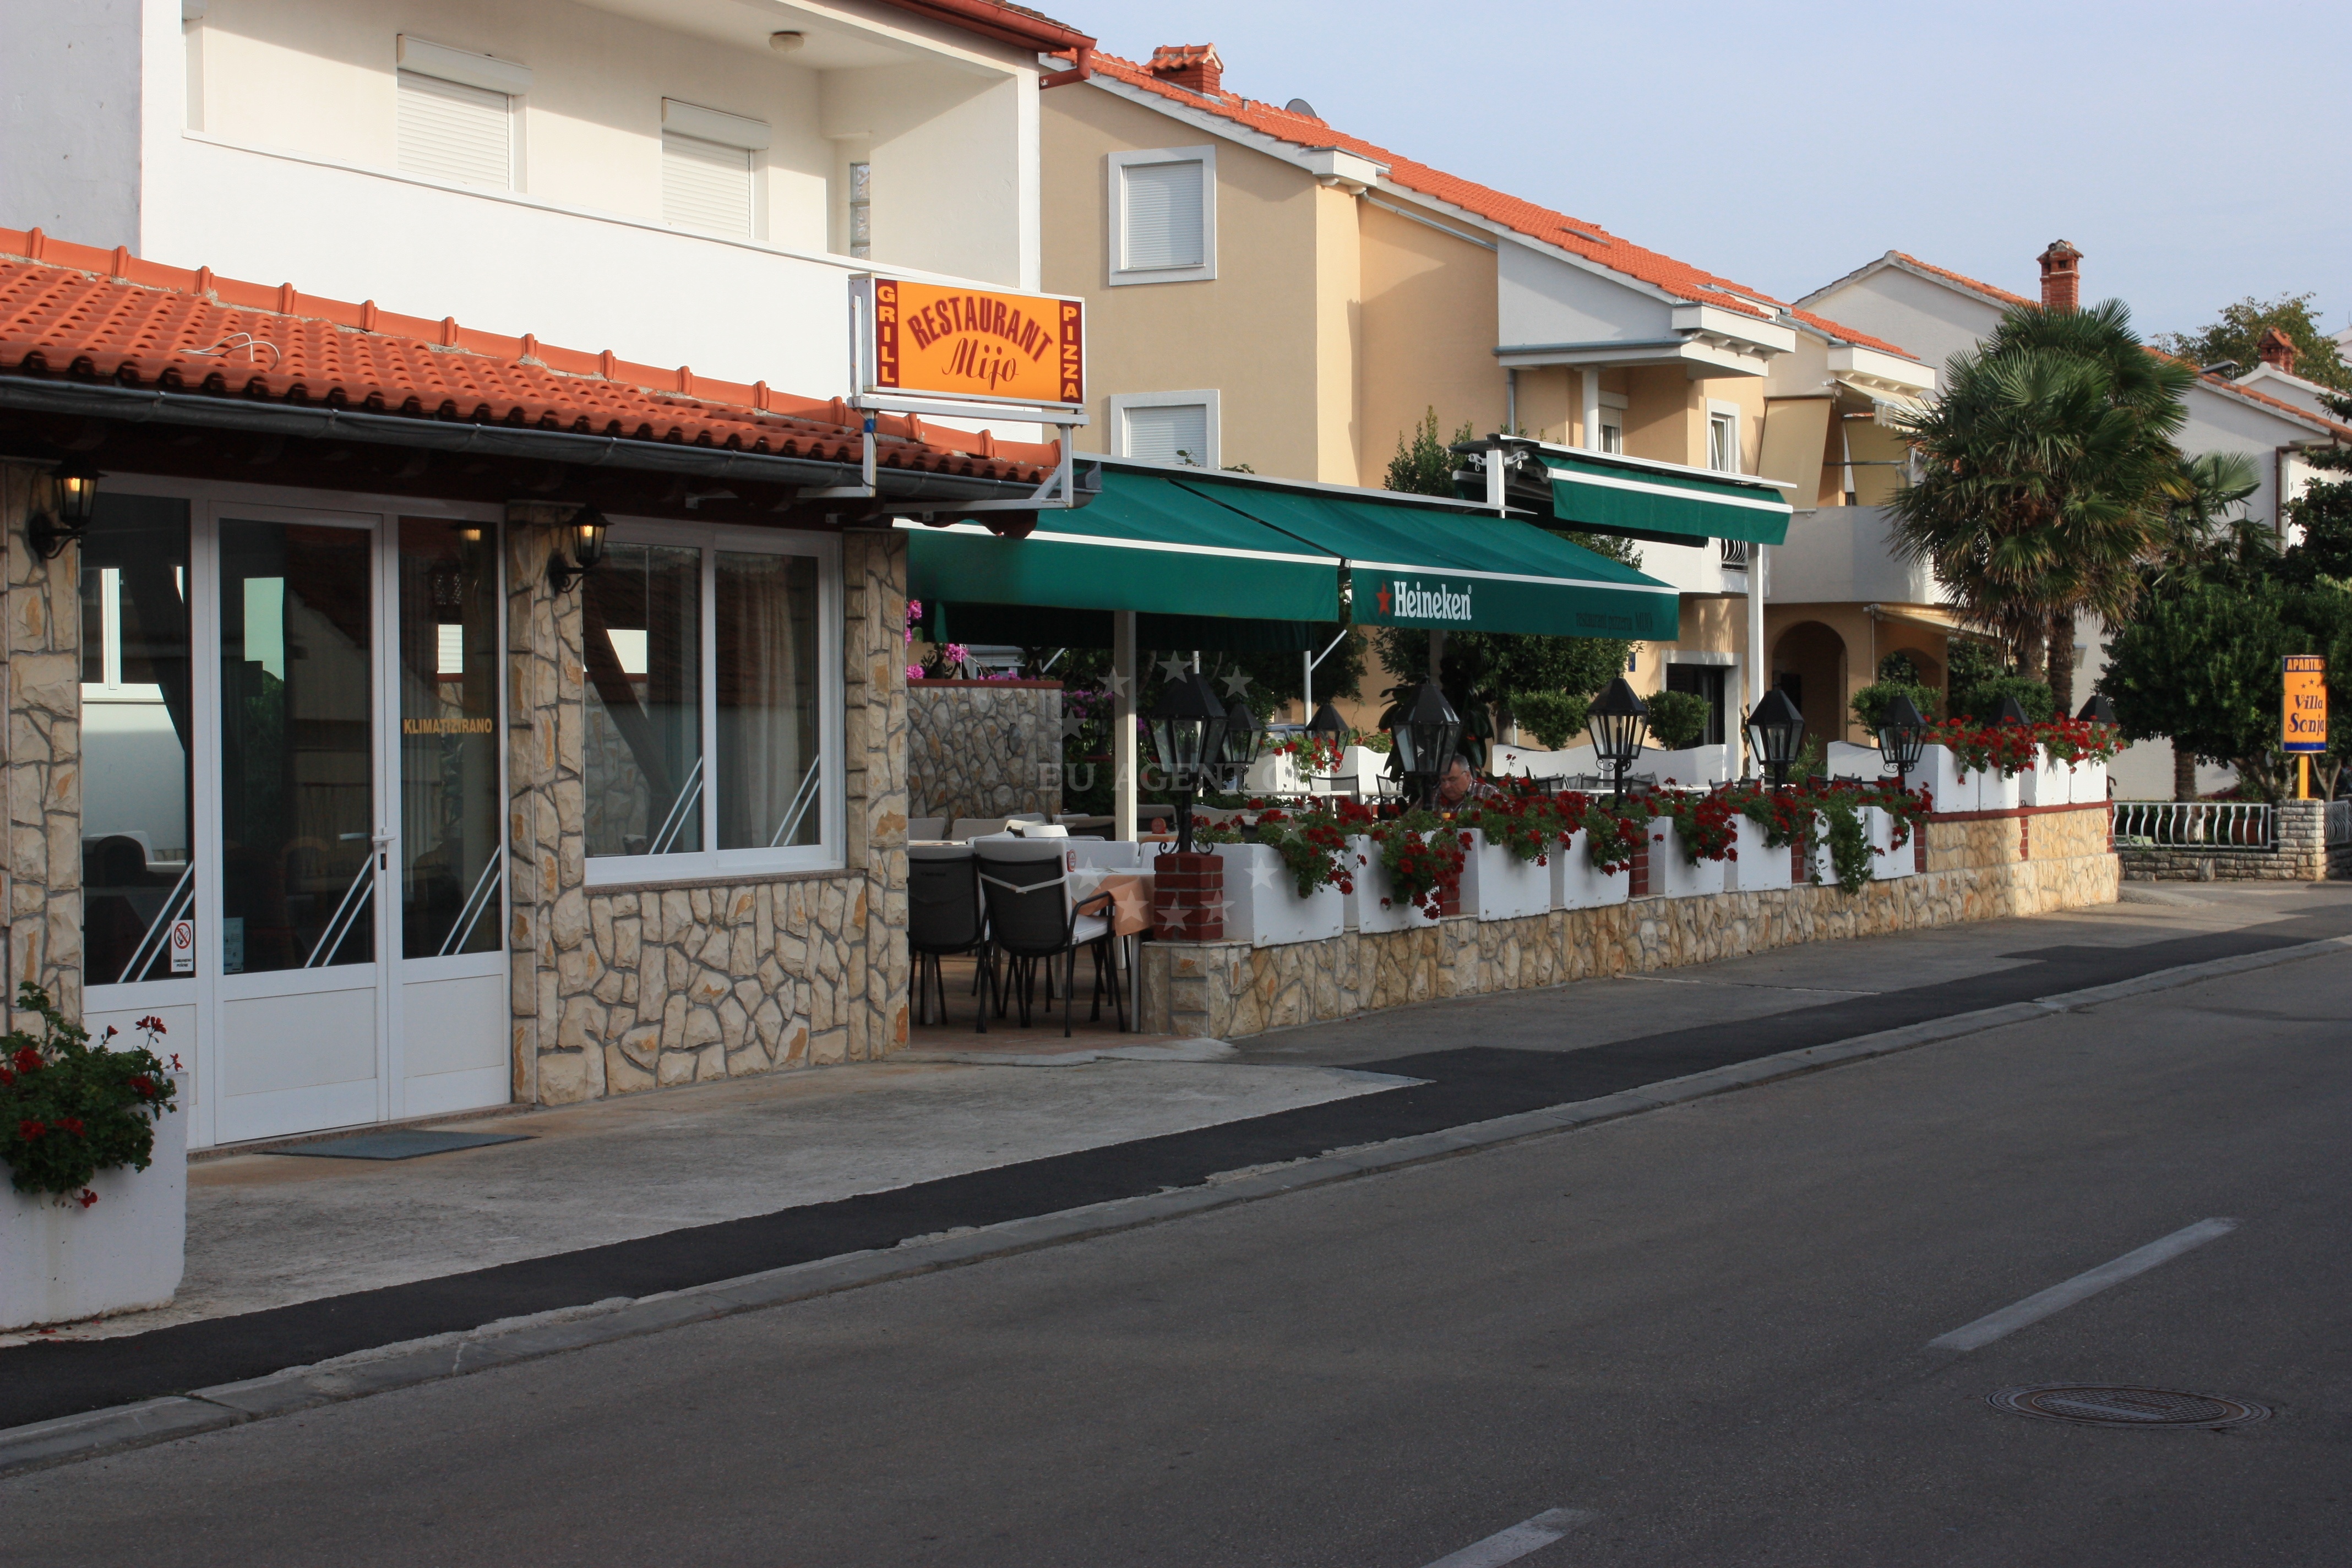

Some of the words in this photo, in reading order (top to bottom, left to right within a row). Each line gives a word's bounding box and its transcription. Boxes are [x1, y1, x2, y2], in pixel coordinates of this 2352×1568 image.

[878, 286, 896, 383] GRILL
[907, 295, 1054, 364] RESTAURANT
[941, 337, 1020, 391] Mijo
[1063, 306, 1079, 399] PIZZA
[1576, 612, 1607, 629] restaurant
[1608, 609, 1632, 635] pizzeria
[2293, 694, 2323, 710] Villa
[403, 718, 493, 734] KLIMATIZIRANO
[2288, 712, 2324, 736] Sonja
